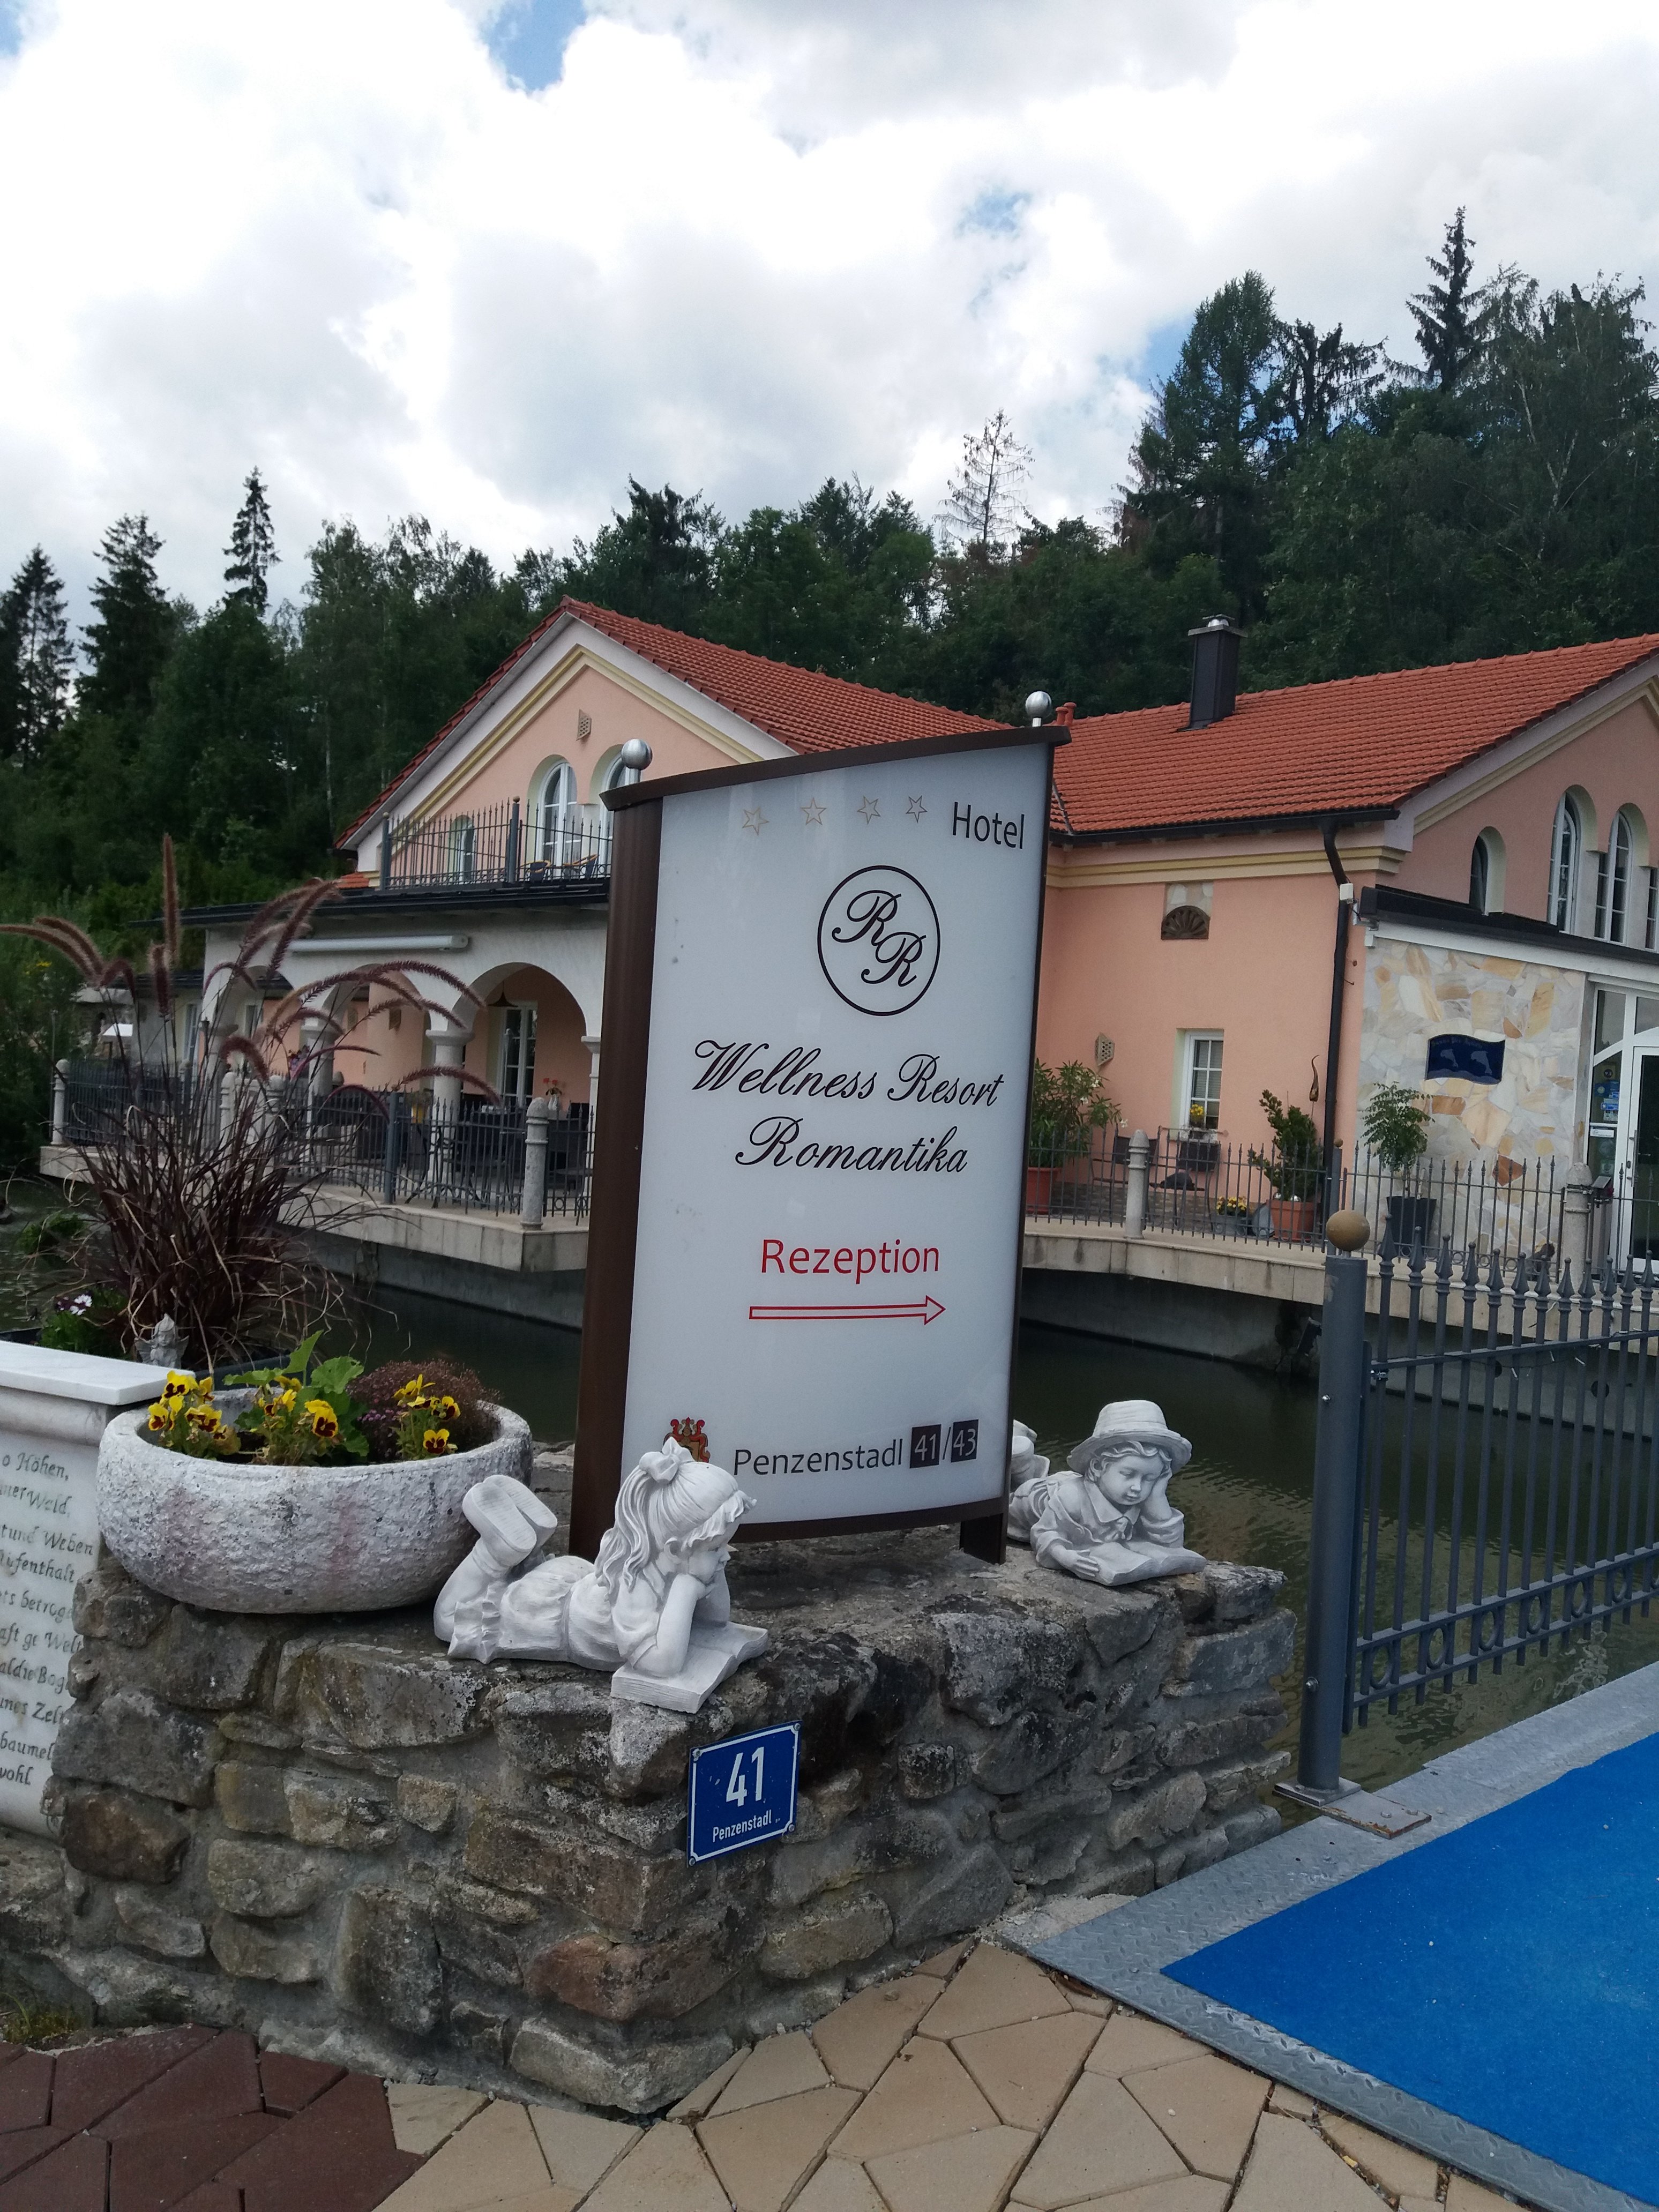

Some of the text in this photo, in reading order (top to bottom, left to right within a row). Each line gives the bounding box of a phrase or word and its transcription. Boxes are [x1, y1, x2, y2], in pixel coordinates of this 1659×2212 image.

[952, 802, 1025, 850] Hotel
[692, 1040, 1004, 1107] Wellness Resort
[735, 1116, 968, 1173] Romantika
[761, 1239, 940, 1284] Rezeption
[734, 1439, 902, 1476] Penzenstadl
[0, 1549, 75, 1583] ufenthalt
[726, 1746, 764, 1807] 41
[713, 1809, 772, 1842] Penzenstadl
